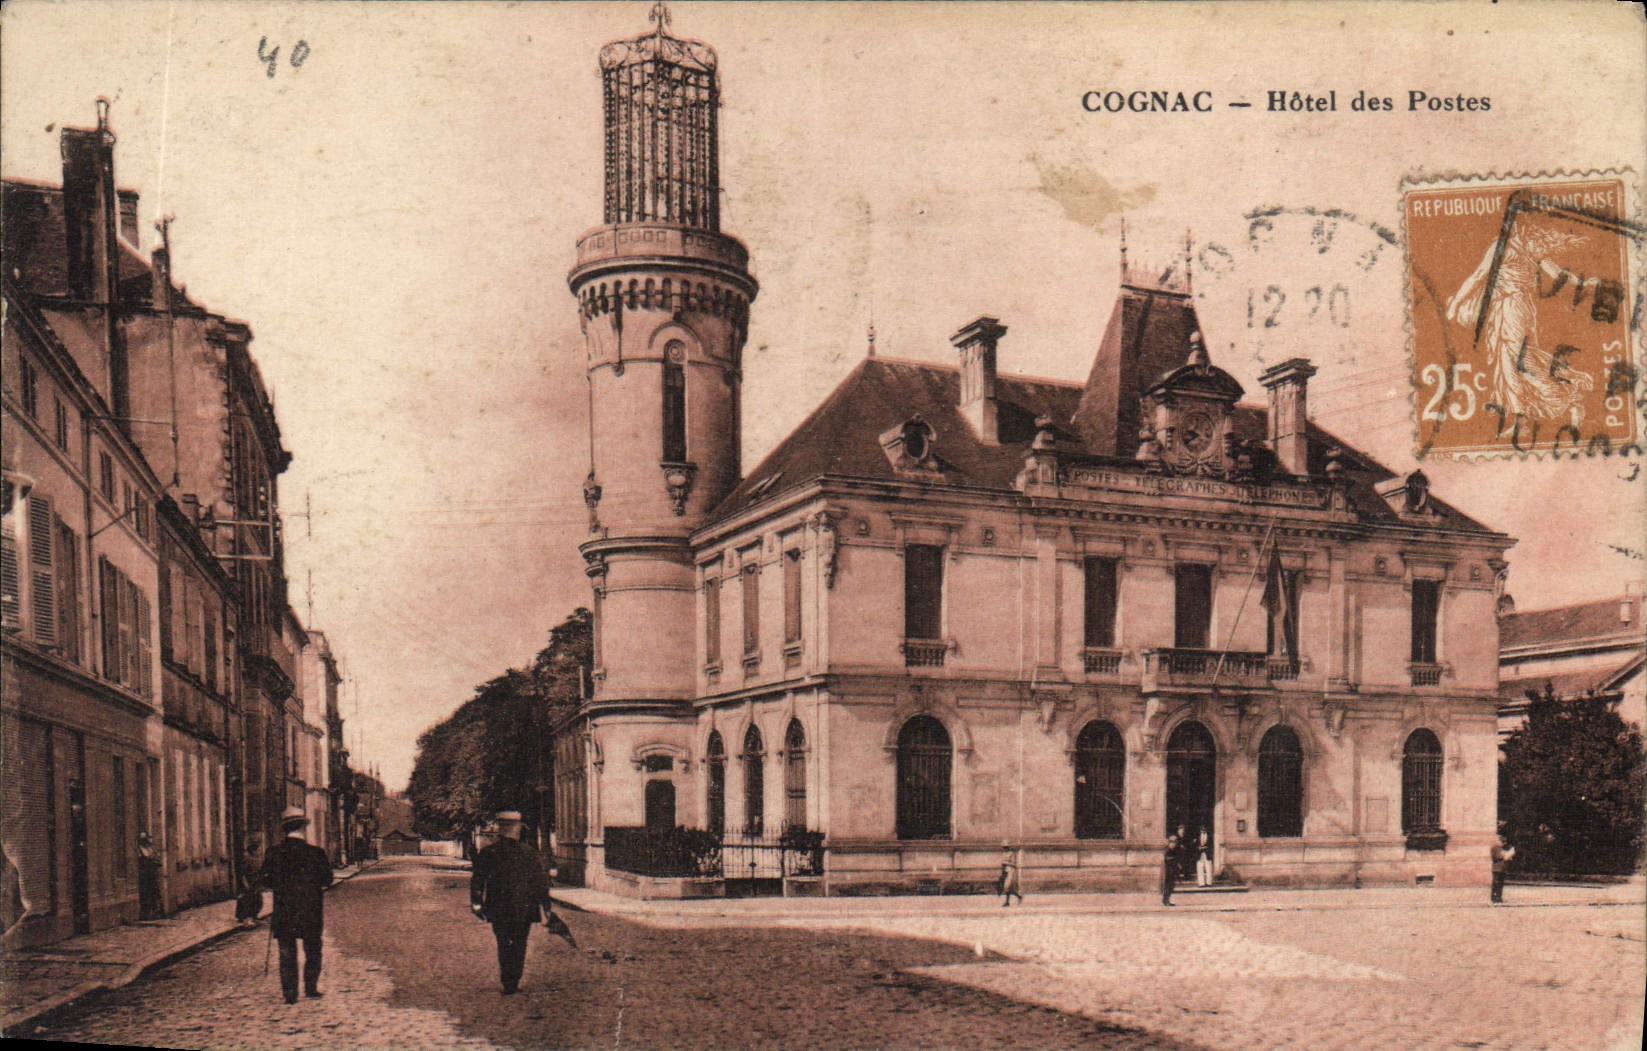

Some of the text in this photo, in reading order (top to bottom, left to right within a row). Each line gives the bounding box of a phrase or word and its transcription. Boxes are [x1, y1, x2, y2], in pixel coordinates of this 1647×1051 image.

[258, 35, 311, 78] 40
[1413, 190, 1615, 217] REPUBLIQUE FRANÇAISE
[1074, 470, 1120, 486] POSTES
